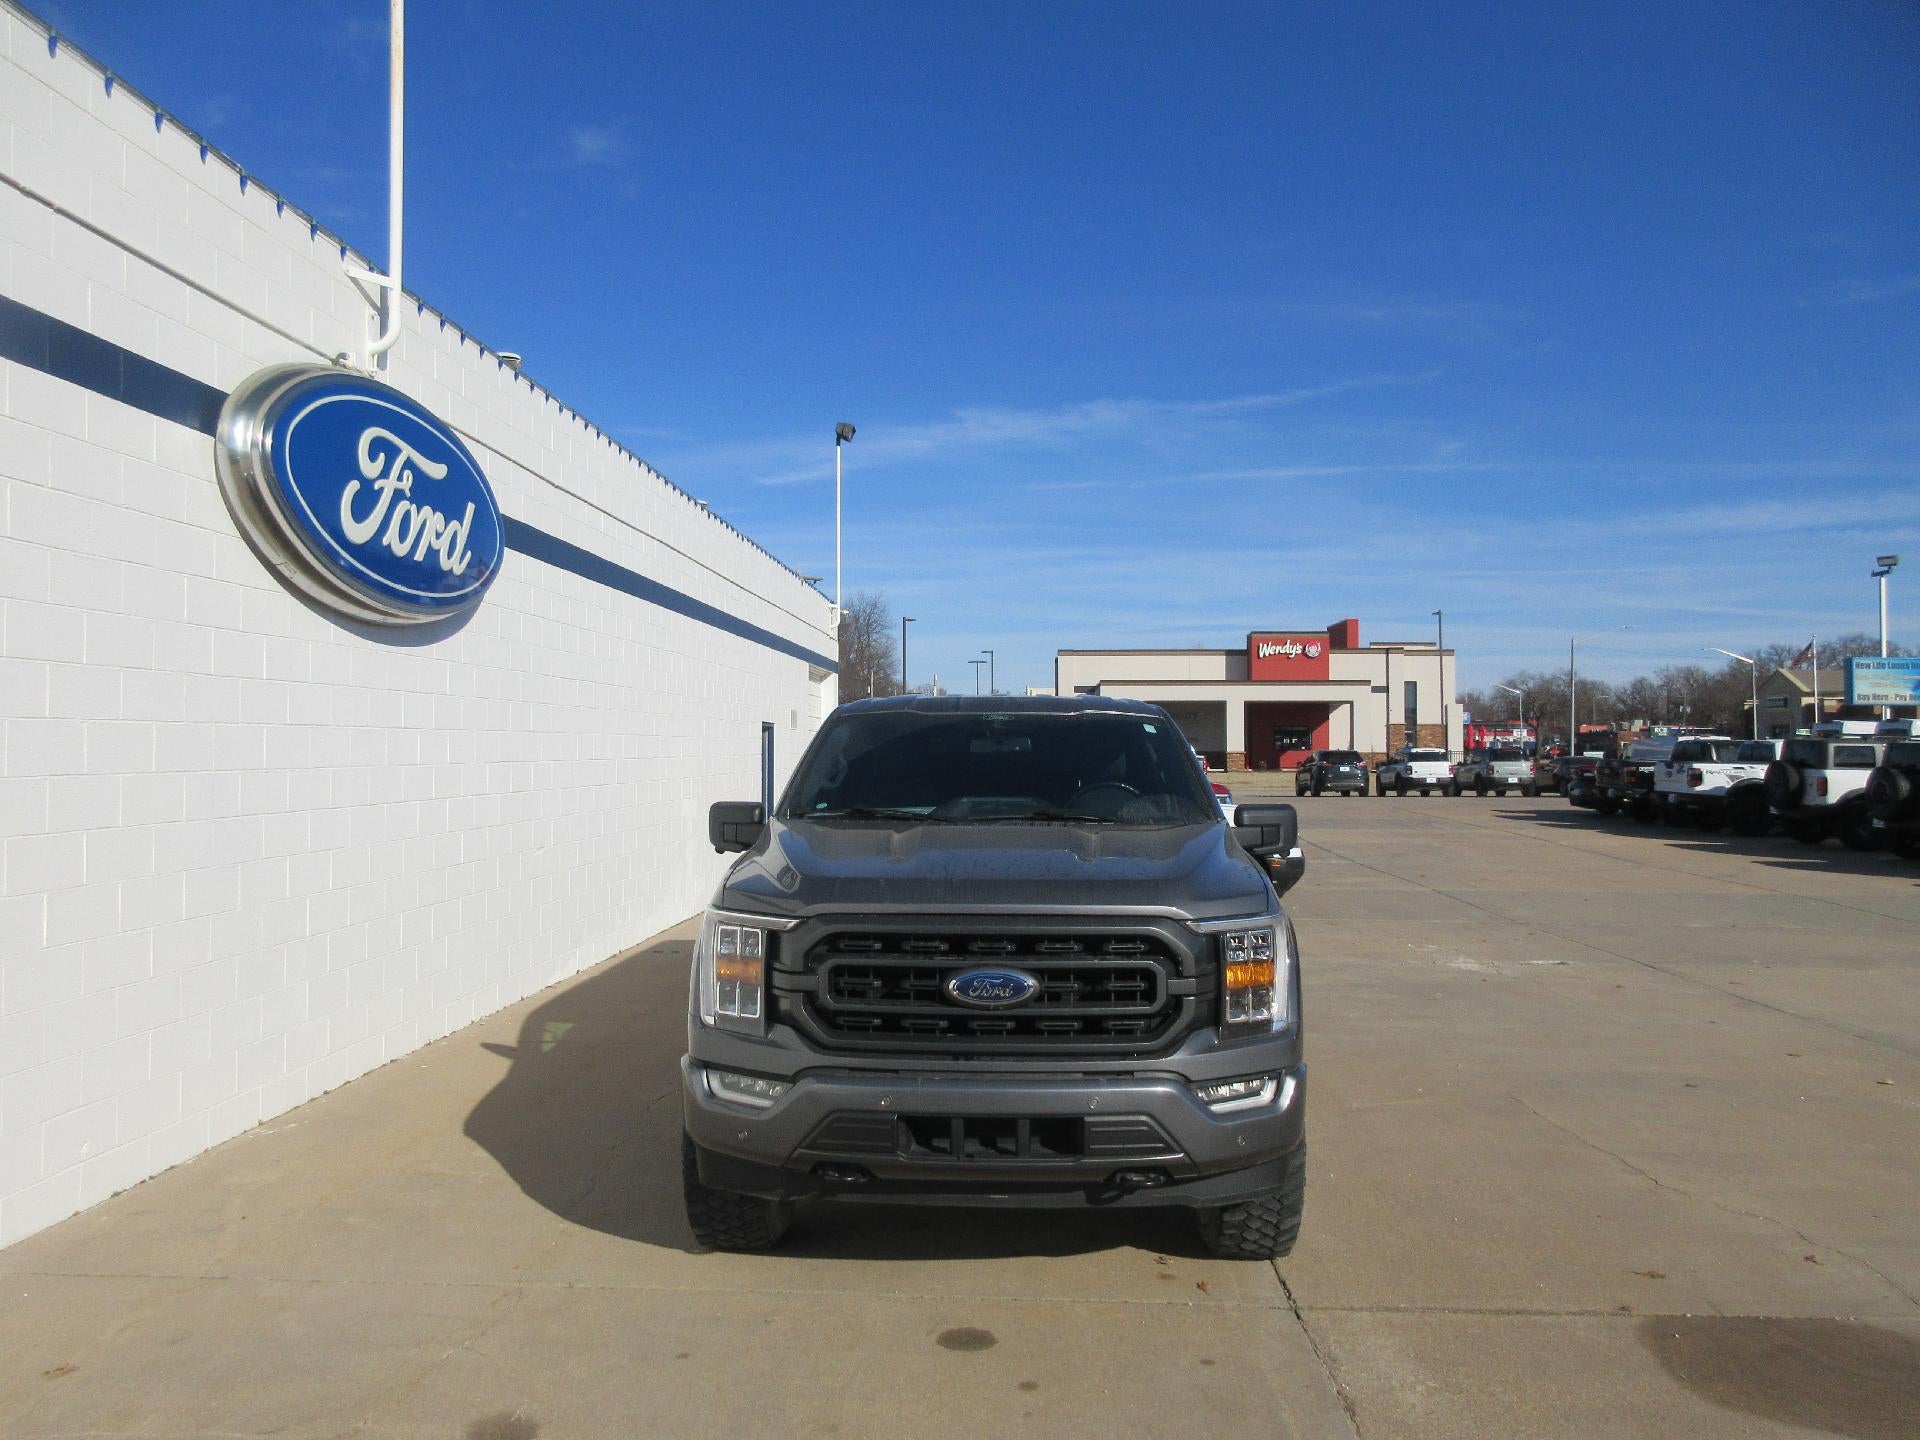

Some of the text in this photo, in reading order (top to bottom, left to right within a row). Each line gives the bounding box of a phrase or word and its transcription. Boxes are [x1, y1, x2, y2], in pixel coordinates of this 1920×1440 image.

[340, 426, 476, 576] Ford
[1258, 639, 1302, 658] Wendy's
[968, 978, 1014, 997] Ford
